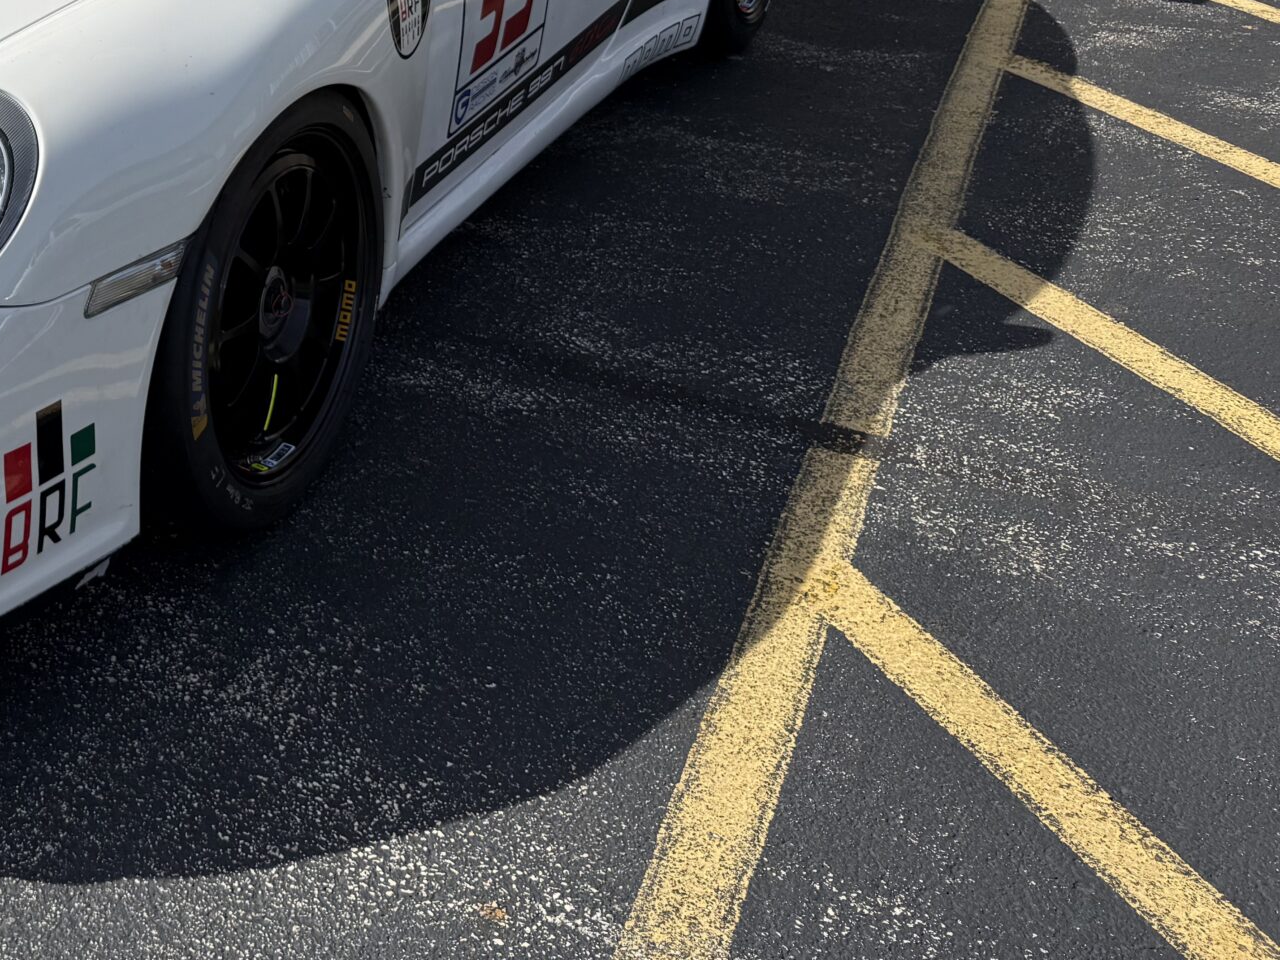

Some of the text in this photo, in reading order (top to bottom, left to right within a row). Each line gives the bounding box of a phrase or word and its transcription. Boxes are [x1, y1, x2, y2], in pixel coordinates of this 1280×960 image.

[422, 89, 526, 188] PORSCHE
[526, 55, 566, 99] 997
[191, 263, 216, 392] MICHELIN
[335, 279, 357, 342] momo
